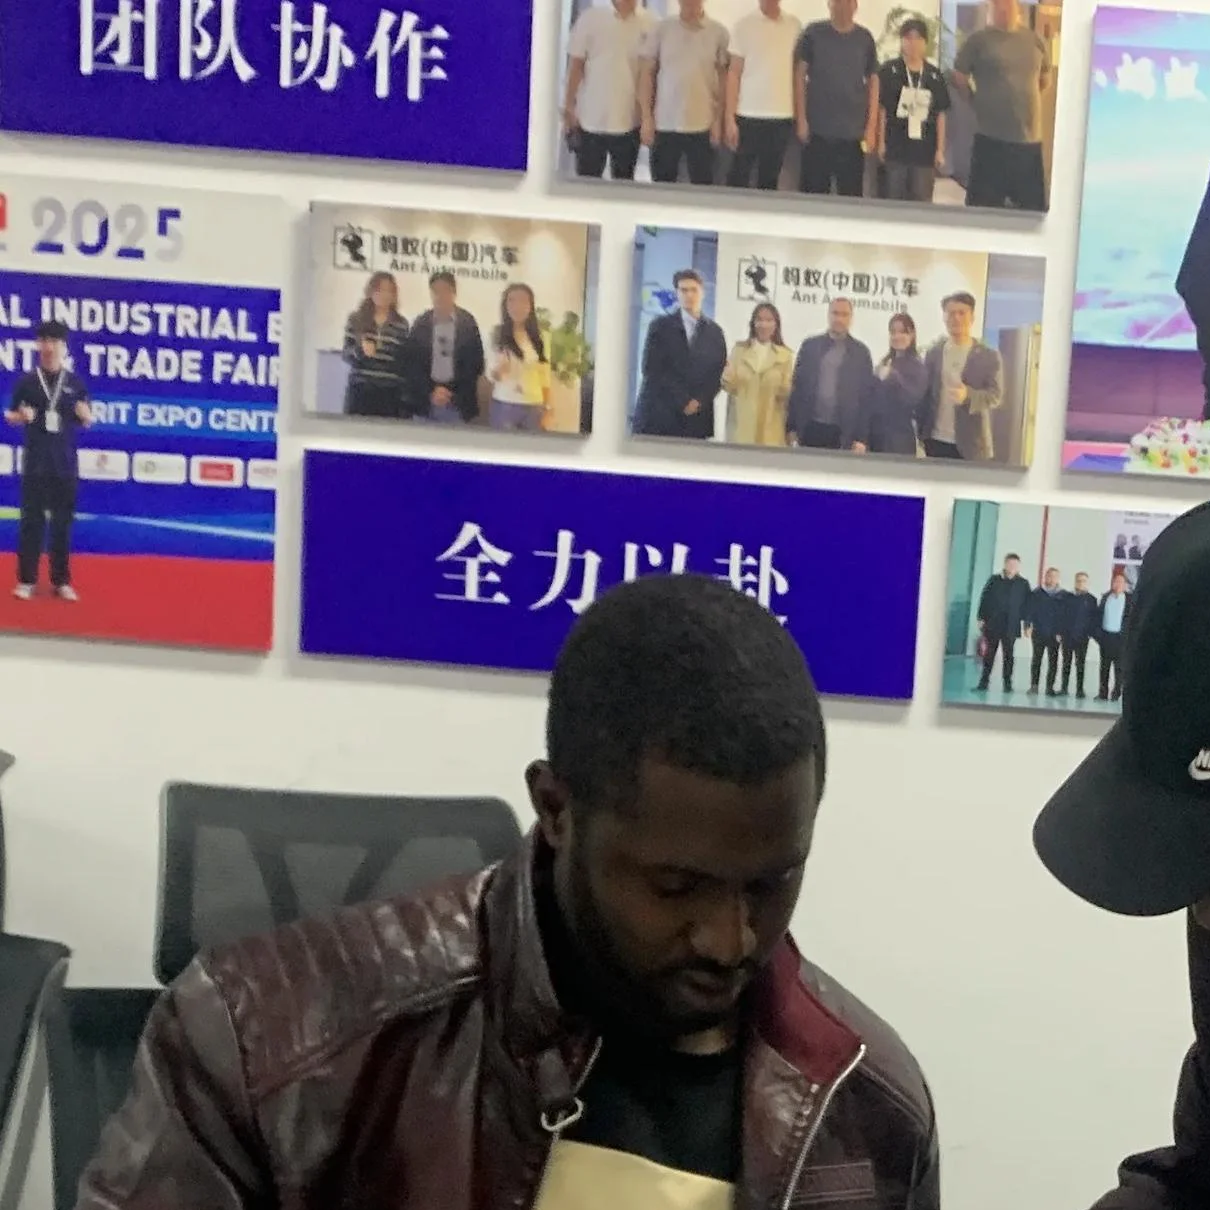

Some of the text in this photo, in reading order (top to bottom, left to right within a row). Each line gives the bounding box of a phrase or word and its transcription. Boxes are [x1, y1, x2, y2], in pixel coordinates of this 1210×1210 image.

[79, 0, 450, 102] 团队协作
[31, 196, 184, 264] 2025
[390, 258, 416, 273] Ant
[792, 290, 817, 304] Ant
[41, 296, 258, 344] INDUSTRIAL
[84, 344, 203, 383] TRADE
[137, 402, 202, 429] EXPO
[208, 407, 279, 434] CENT
